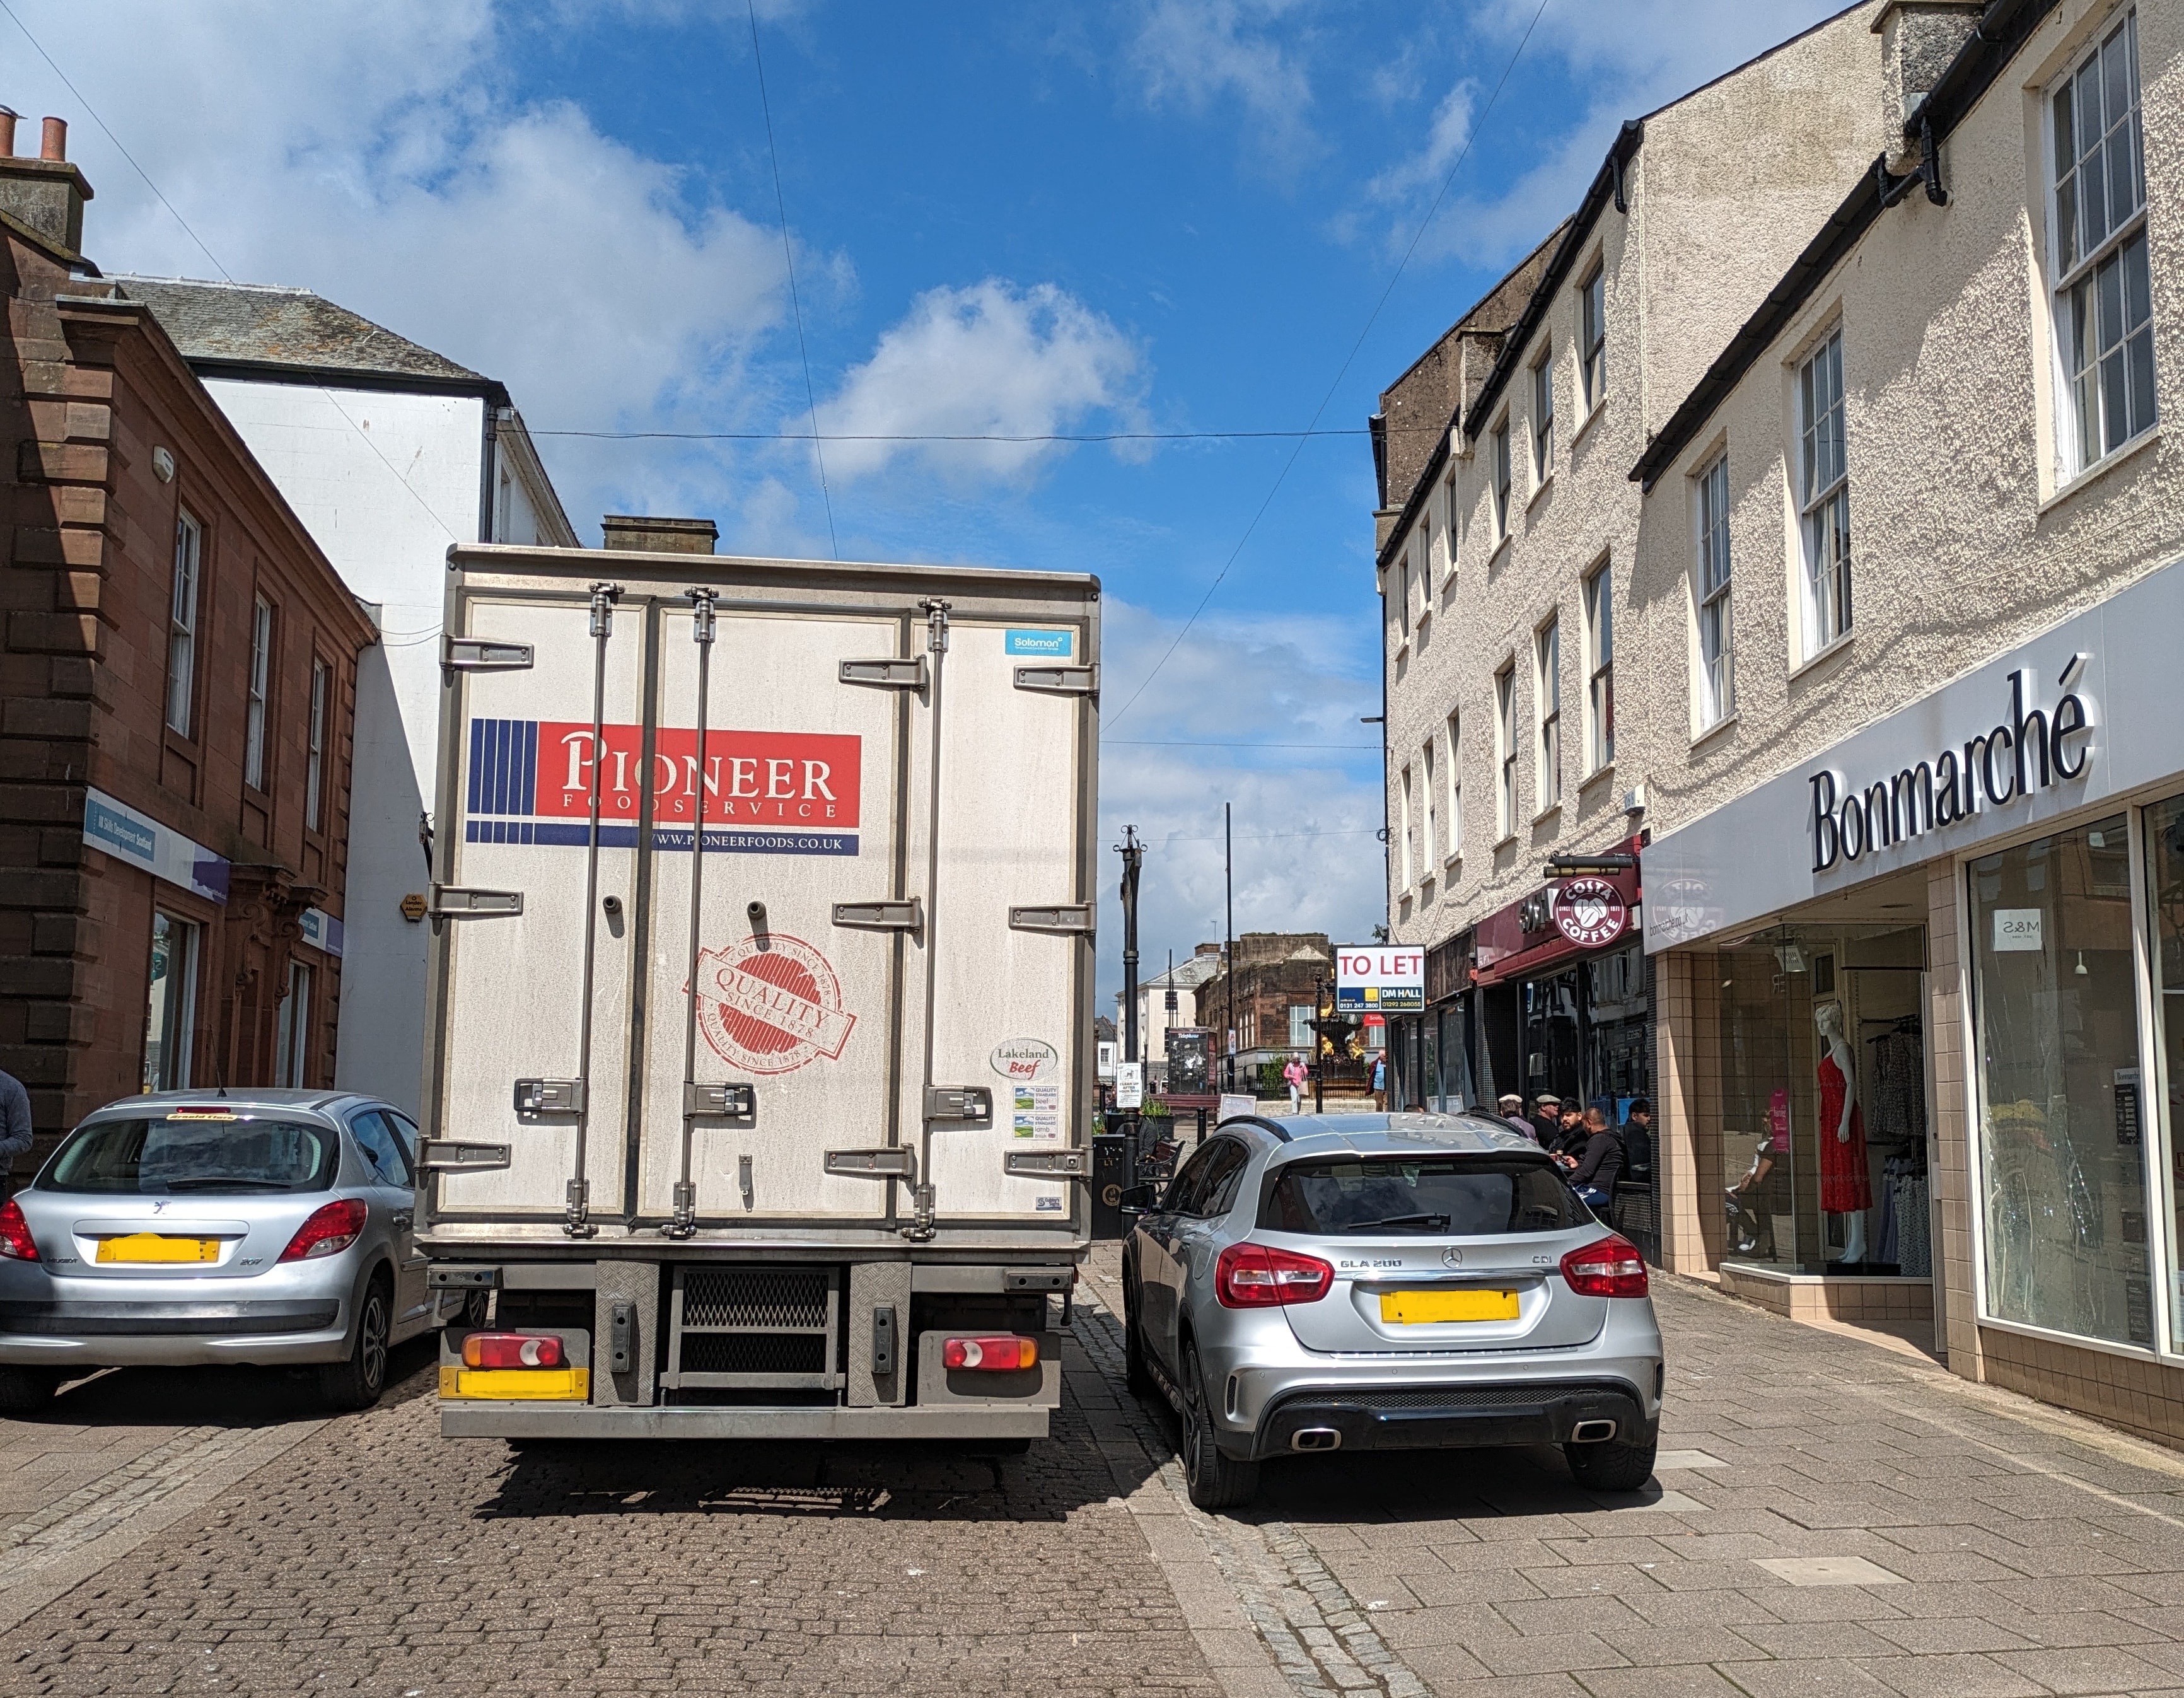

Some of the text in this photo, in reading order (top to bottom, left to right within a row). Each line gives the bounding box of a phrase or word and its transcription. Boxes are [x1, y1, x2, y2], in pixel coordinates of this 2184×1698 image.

[561, 731, 837, 801] PIONEER
[1809, 653, 2094, 874] Bonmarché
[1565, 880, 1612, 900] COSTA
[1562, 918, 1619, 942] COFFEE
[791, 947, 820, 972] SINCE
[818, 971, 831, 996] 1878
[1339, 955, 1423, 975] TO LET
[714, 968, 830, 1029] QUALITY
[1382, 989, 1397, 998] DM
[1398, 989, 1421, 997] HALL
[725, 992, 814, 1038] SINCE 1878
[707, 1013, 801, 1066] QUALITY SINCE 1878
[997, 1048, 1049, 1059] Lakeland
[1009, 1059, 1041, 1080] Beef
[240, 1257, 264, 1266] 207
[1340, 1260, 1370, 1268] GLA
[1532, 1255, 1552, 1264] CDI
